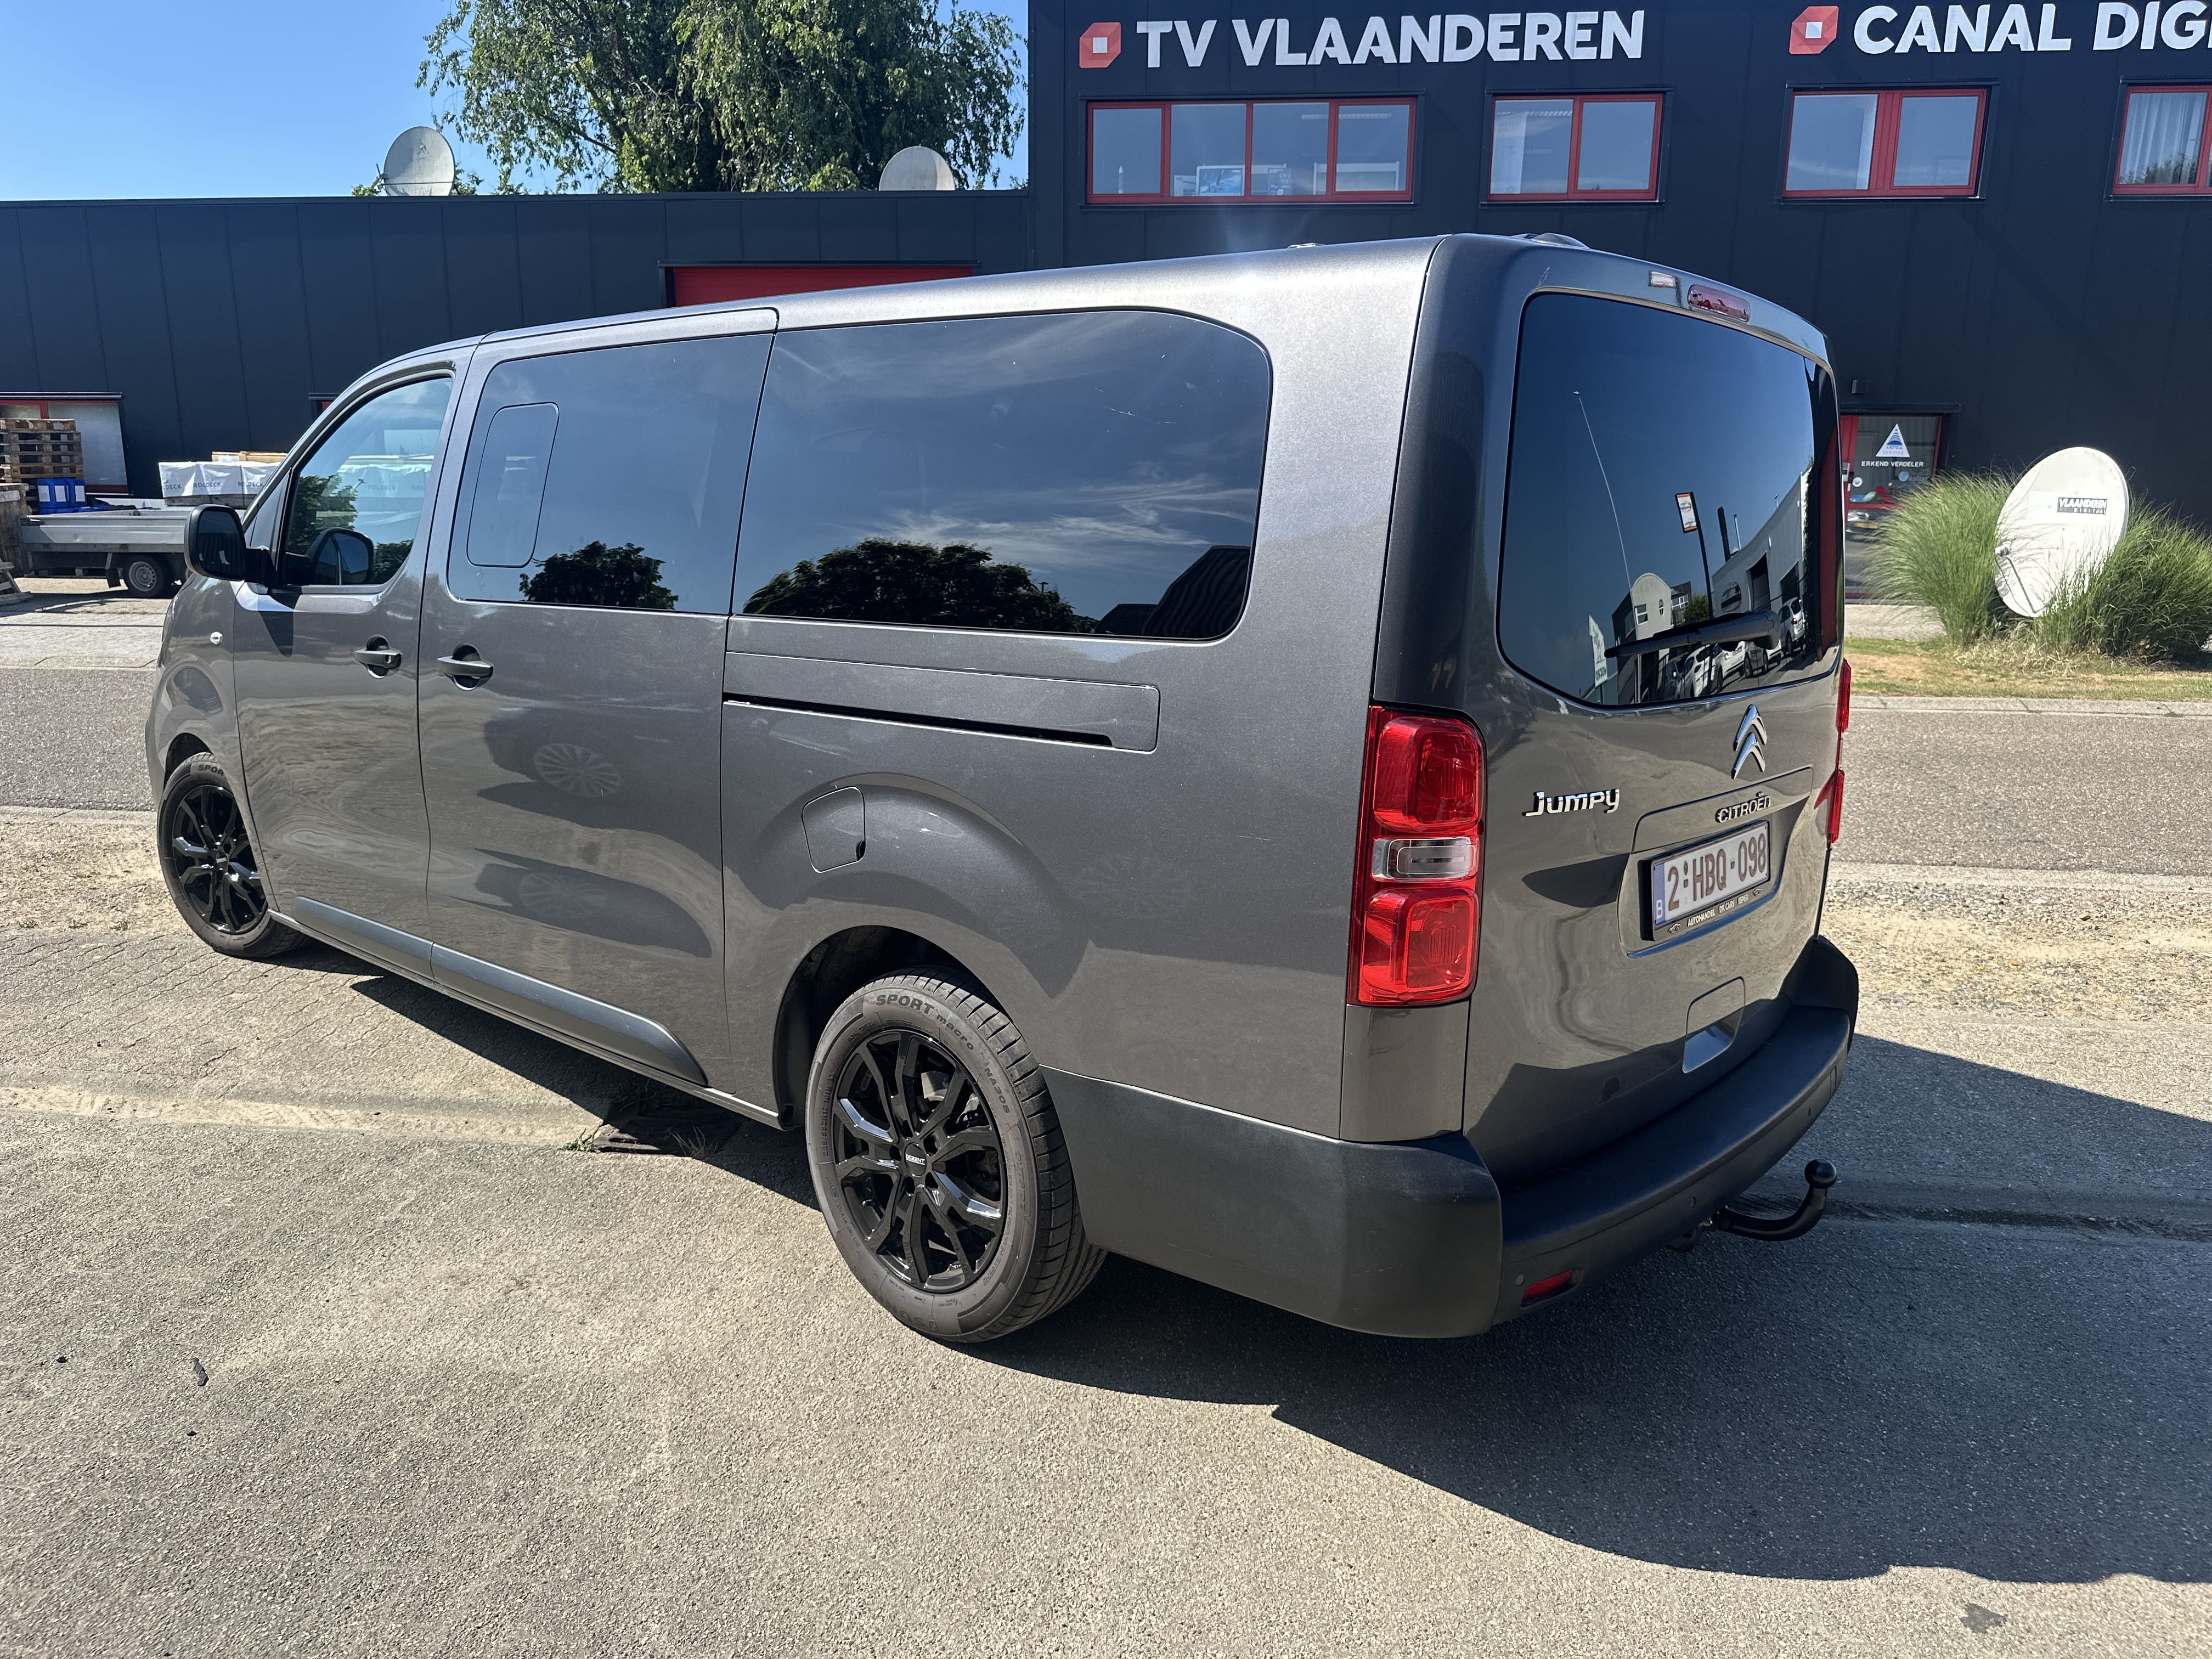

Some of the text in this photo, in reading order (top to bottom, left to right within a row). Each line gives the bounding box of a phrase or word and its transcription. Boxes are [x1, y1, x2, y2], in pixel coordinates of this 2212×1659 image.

[1136, 10, 1645, 68] TV VLAANDEREN
[1854, 0, 2212, 54] CANAL DIG
[2059, 498, 2107, 509] VLAANDEREN
[1522, 788, 1620, 817] Jumpy
[1715, 791, 1771, 823] CITROËN
[1656, 899, 1663, 919] B
[1688, 909, 1716, 927] AUTOHANDEL
[876, 994, 974, 1051] SPORT macro
